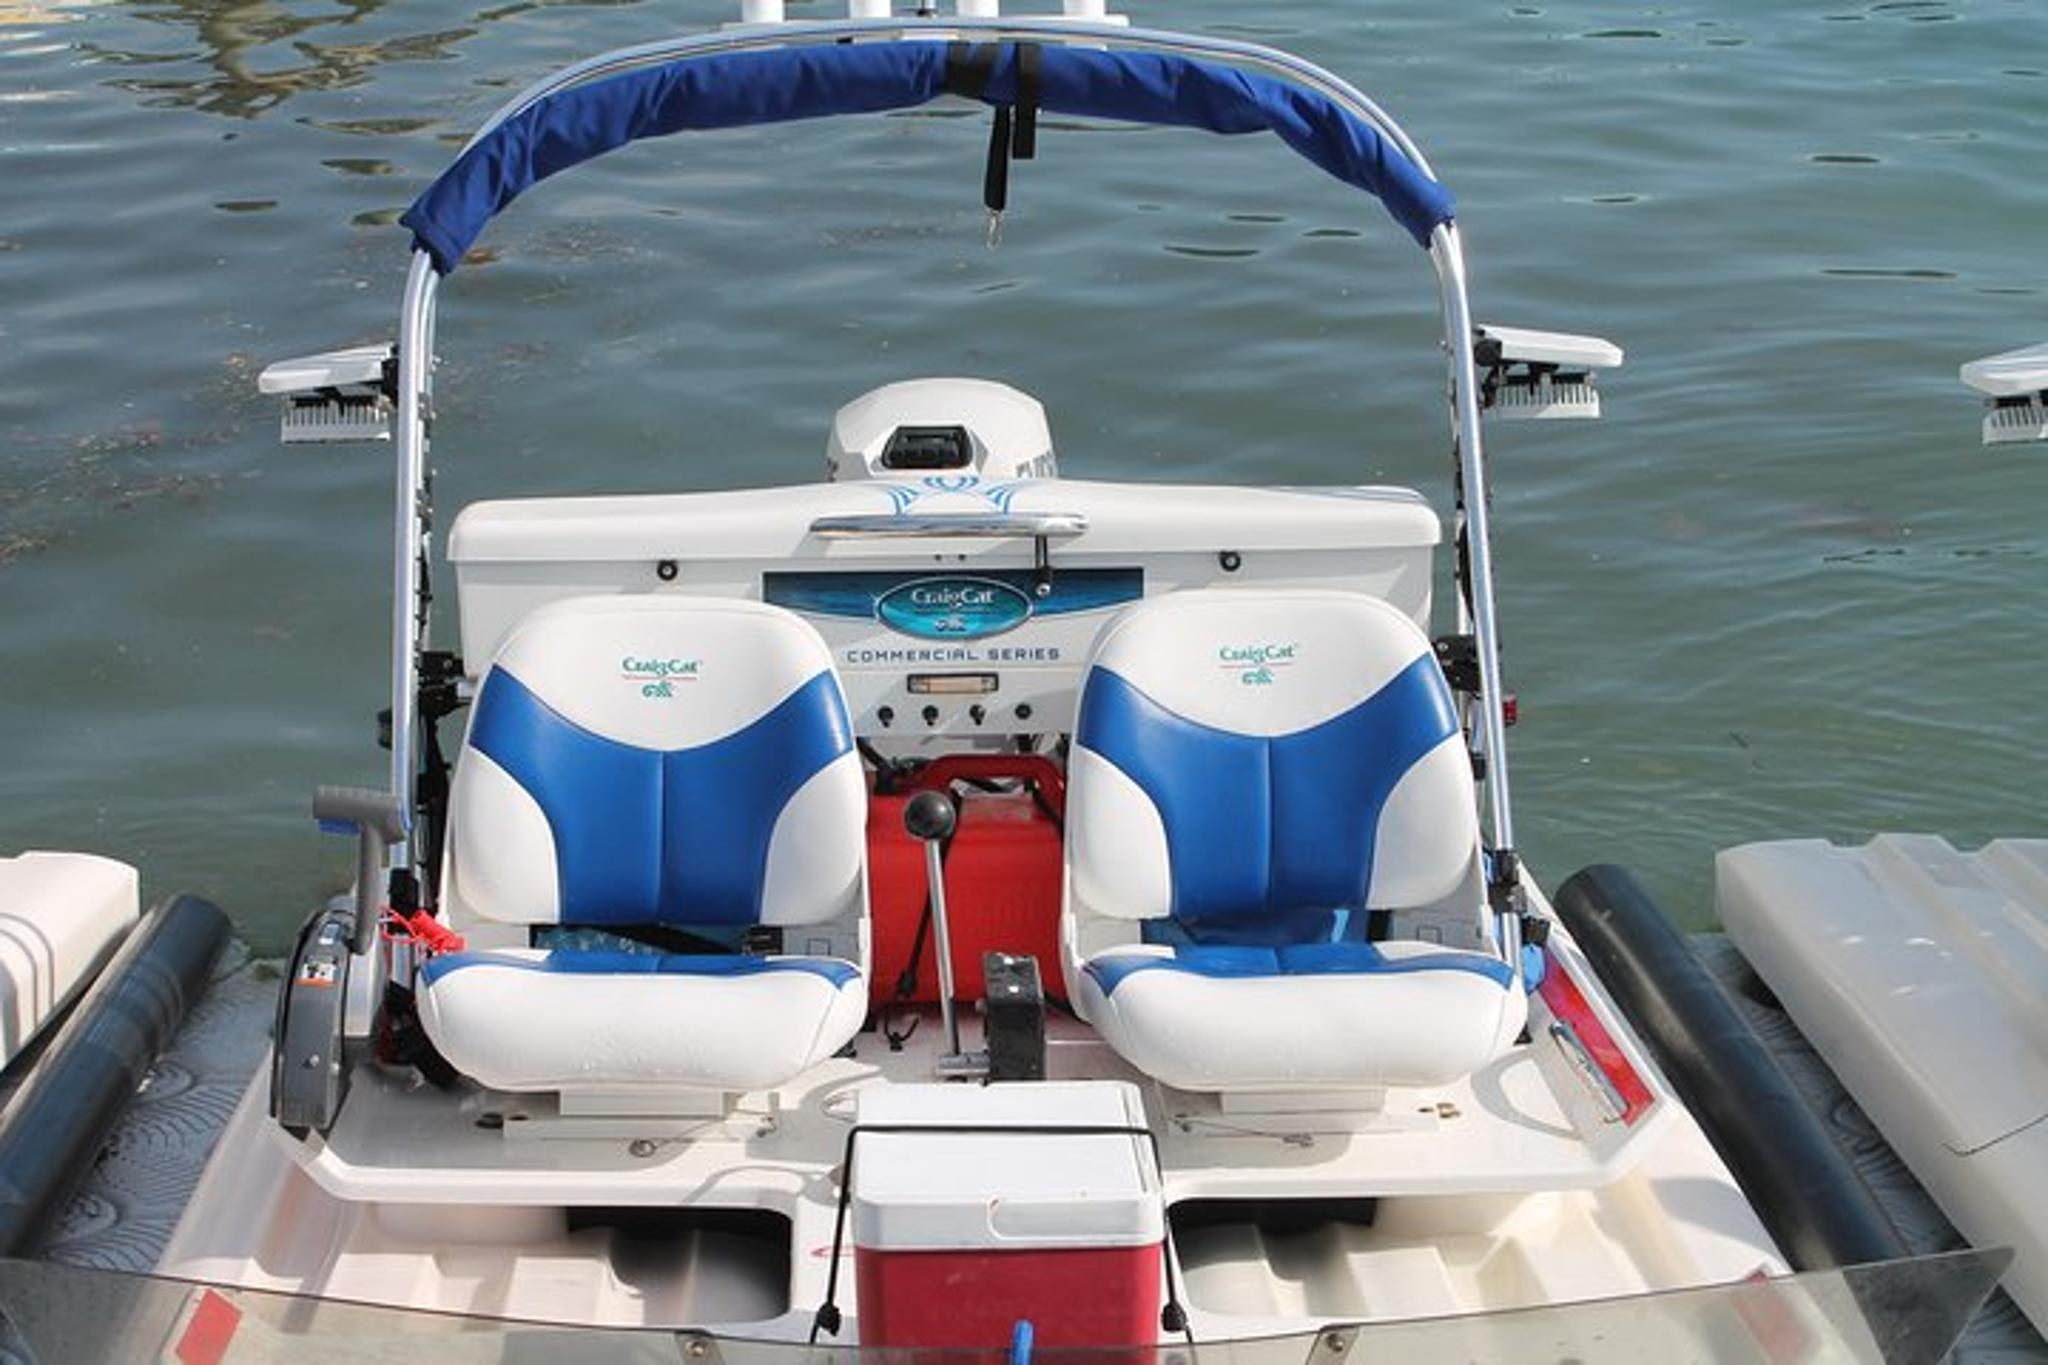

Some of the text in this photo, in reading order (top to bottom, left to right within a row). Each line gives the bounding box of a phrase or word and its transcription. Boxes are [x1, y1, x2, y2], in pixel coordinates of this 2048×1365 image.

[911, 586, 995, 606] CraigCat
[846, 647, 1060, 664] COMMERCIAL SERIES
[1219, 643, 1295, 663] CraigCat
[622, 656, 698, 675] CraigCat
